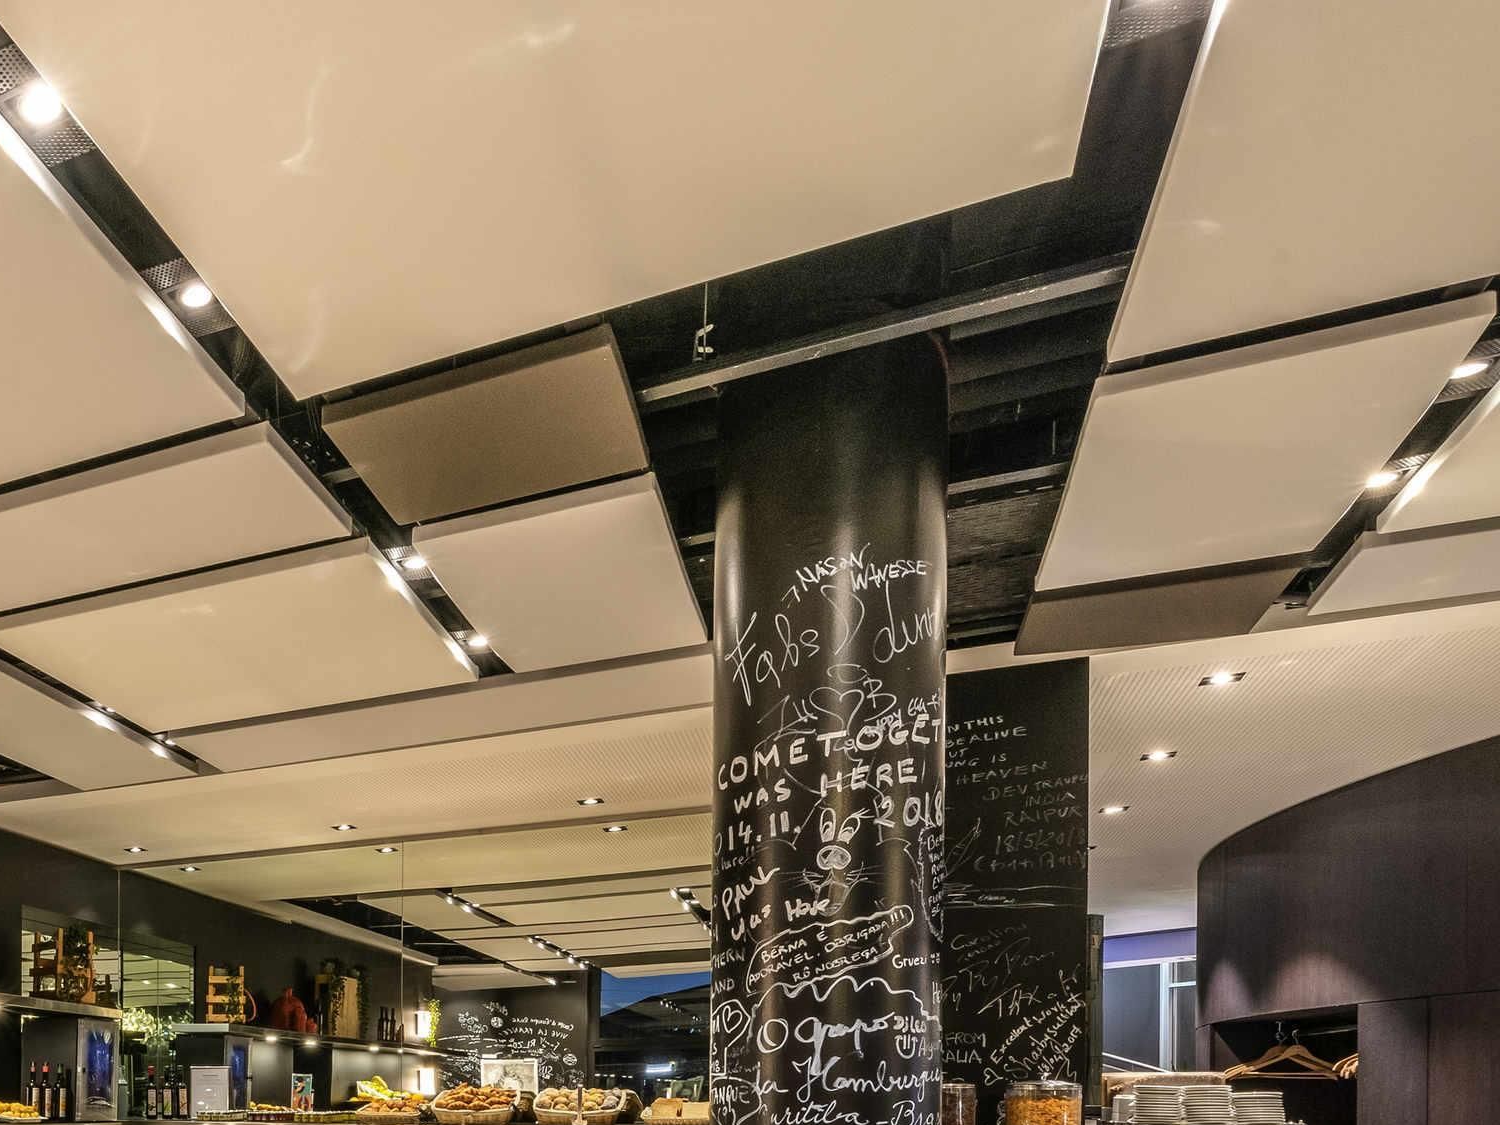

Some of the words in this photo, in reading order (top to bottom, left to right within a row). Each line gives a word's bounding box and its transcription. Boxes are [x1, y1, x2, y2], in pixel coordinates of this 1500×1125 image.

[963, 714, 1005, 731] THIS
[718, 737, 808, 790] COME
[956, 760, 1048, 786] HEAVEN
[734, 778, 791, 814] WAS
